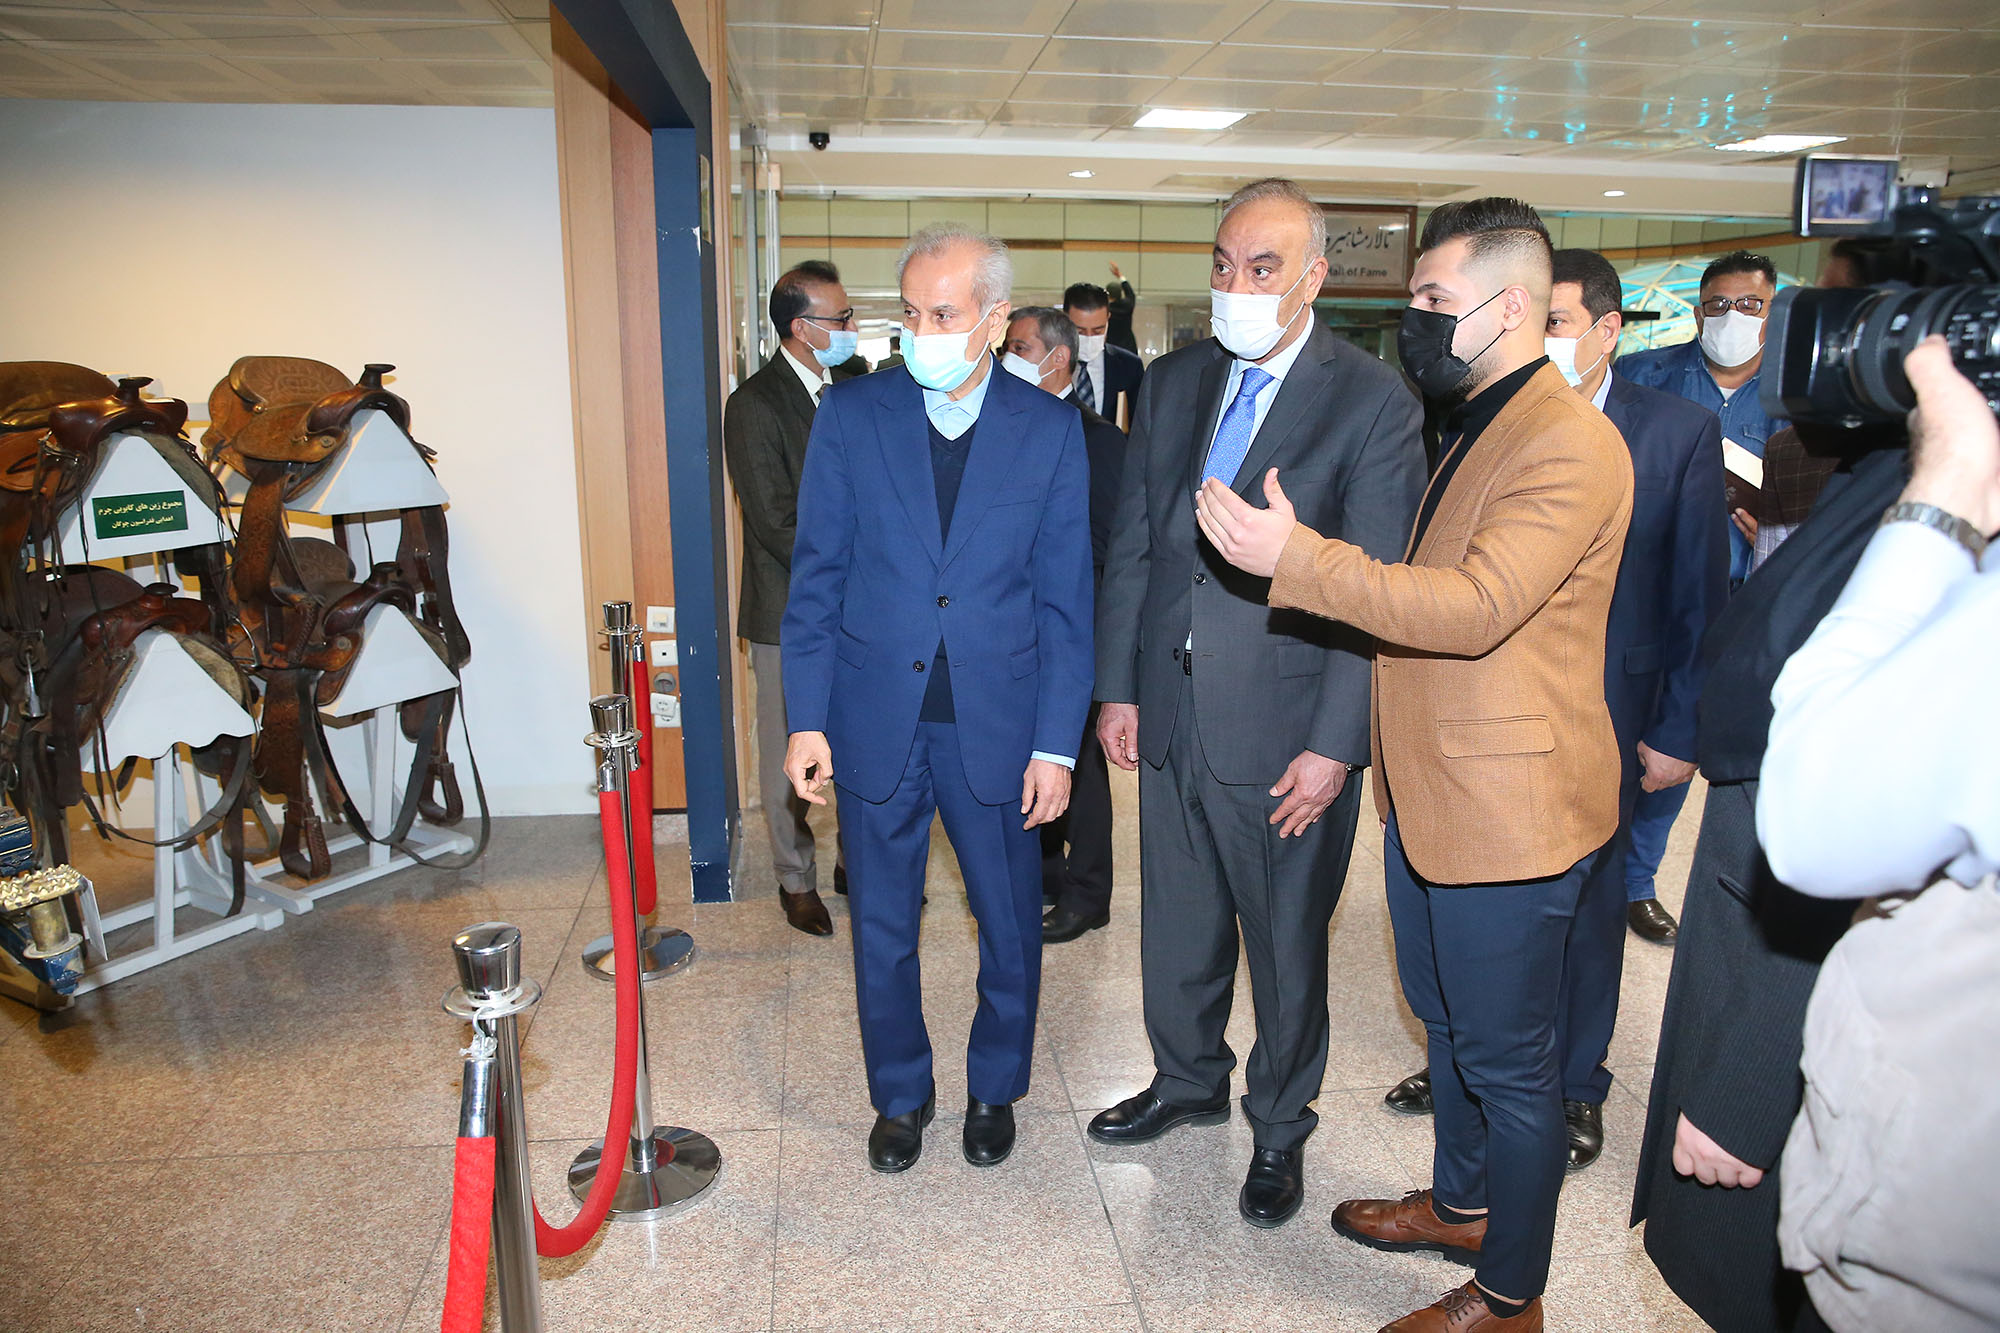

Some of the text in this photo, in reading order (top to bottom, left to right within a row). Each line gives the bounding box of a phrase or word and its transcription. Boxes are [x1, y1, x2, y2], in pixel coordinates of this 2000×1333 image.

[1366, 230, 1394, 249] تالار
[1346, 266, 1357, 277] of
[1360, 266, 1387, 277] Fame
[135, 503, 148, 512] های
[149, 502, 161, 510] زین
[130, 518, 155, 526] فدراسیون
